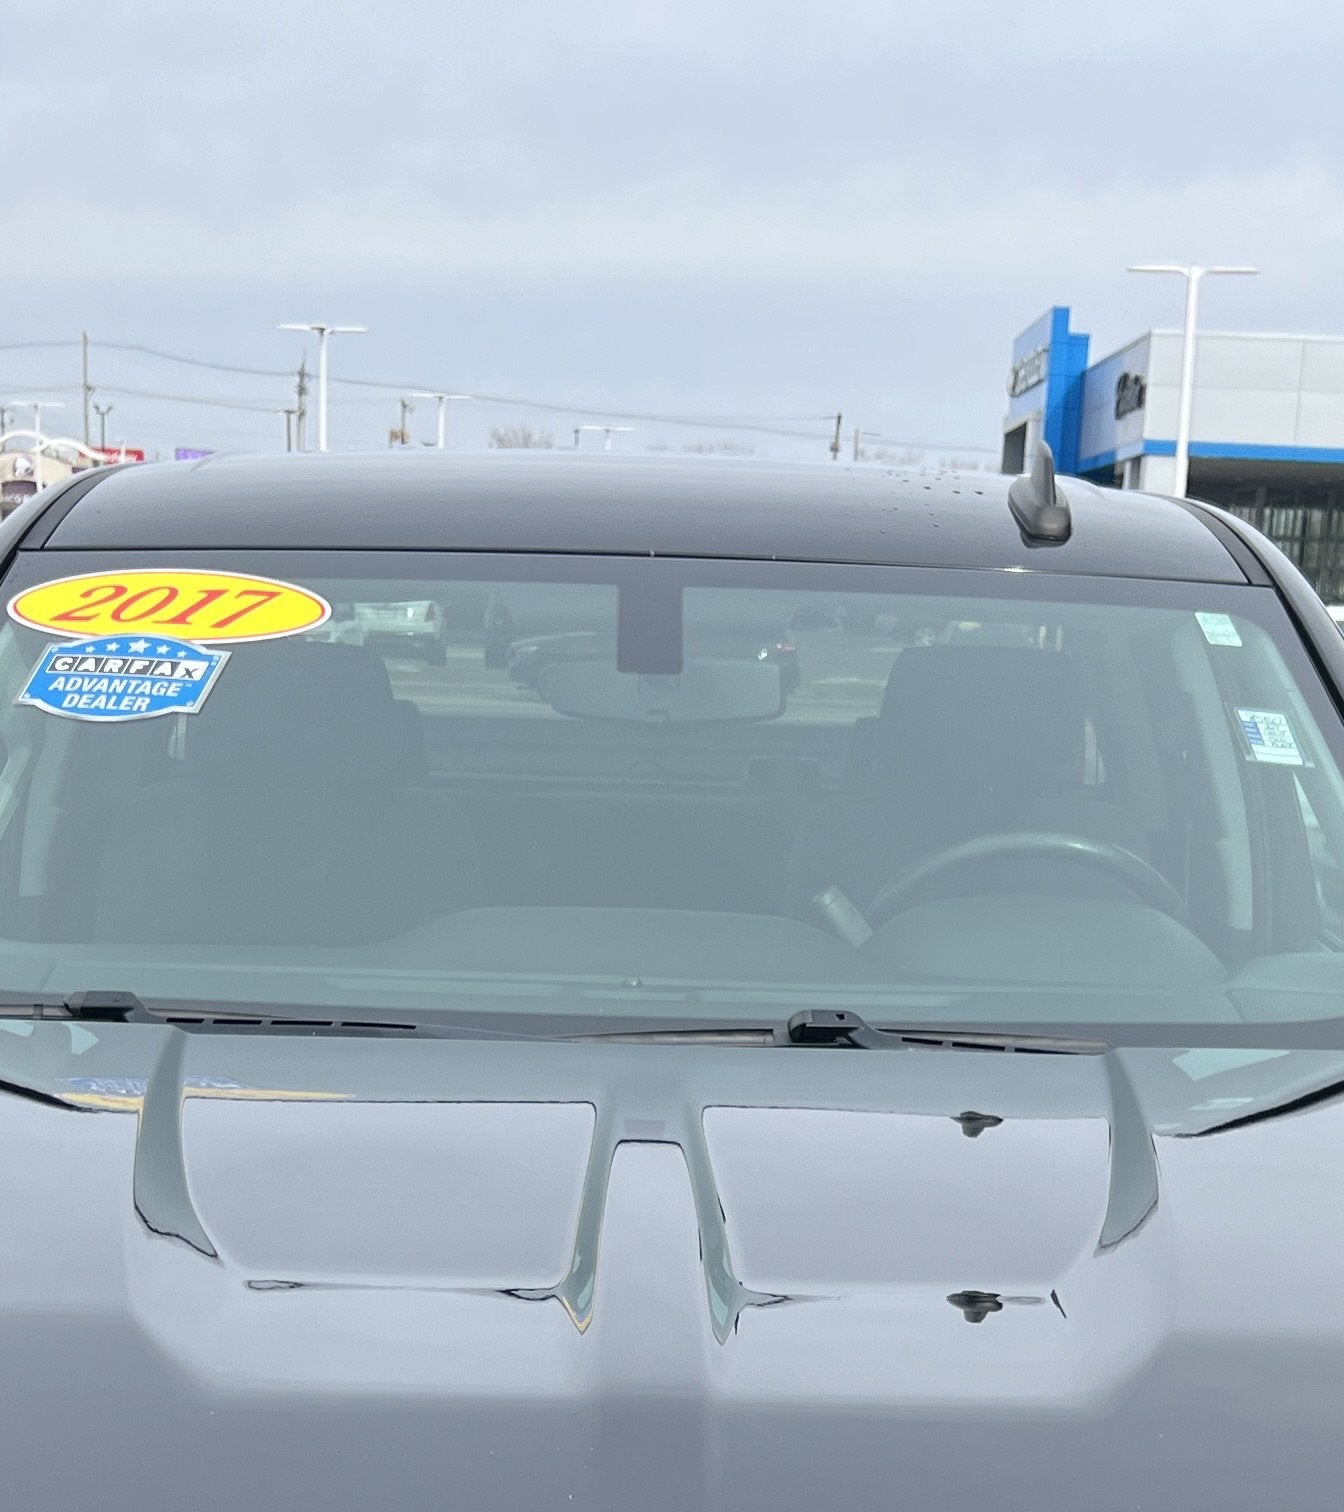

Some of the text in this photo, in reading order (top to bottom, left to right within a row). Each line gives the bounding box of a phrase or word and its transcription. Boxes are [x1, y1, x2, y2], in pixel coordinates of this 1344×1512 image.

[50, 585, 284, 629] 2017
[53, 656, 200, 679] CARFAX
[48, 677, 184, 697] ADVANTAGE
[61, 693, 151, 712] DEALER
